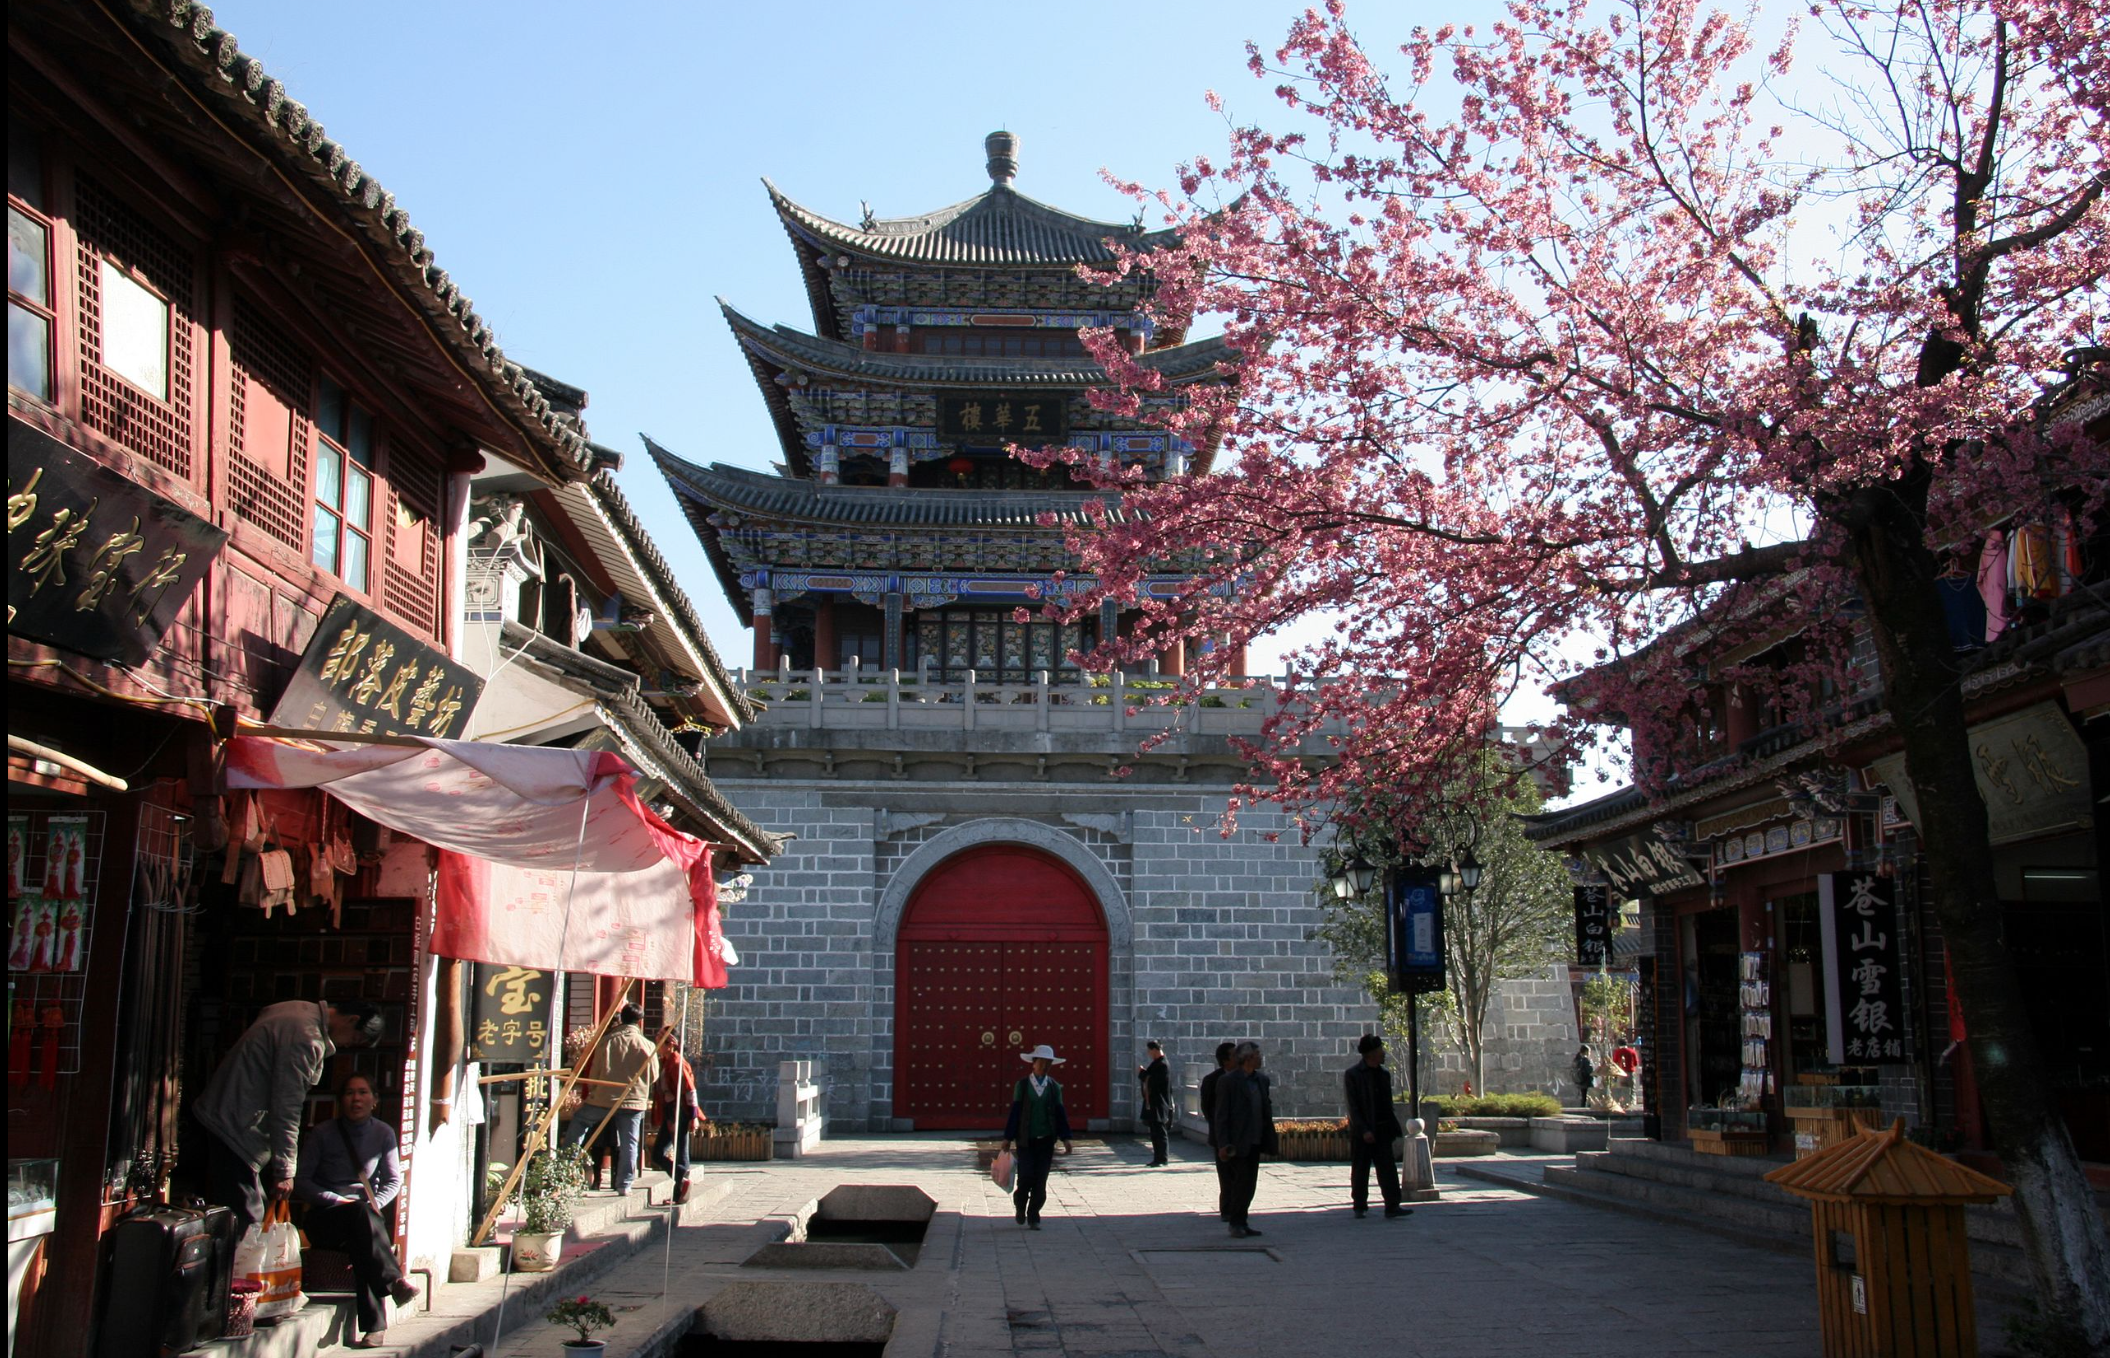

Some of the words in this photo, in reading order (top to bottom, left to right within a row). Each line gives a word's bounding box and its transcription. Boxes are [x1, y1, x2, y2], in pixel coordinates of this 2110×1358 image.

[959, 401, 1042, 433] 五華樓
[1580, 887, 1606, 953] 苍山白银
[1843, 878, 1893, 1034] 苍山雪银
[477, 1018, 547, 1048] 老字号
